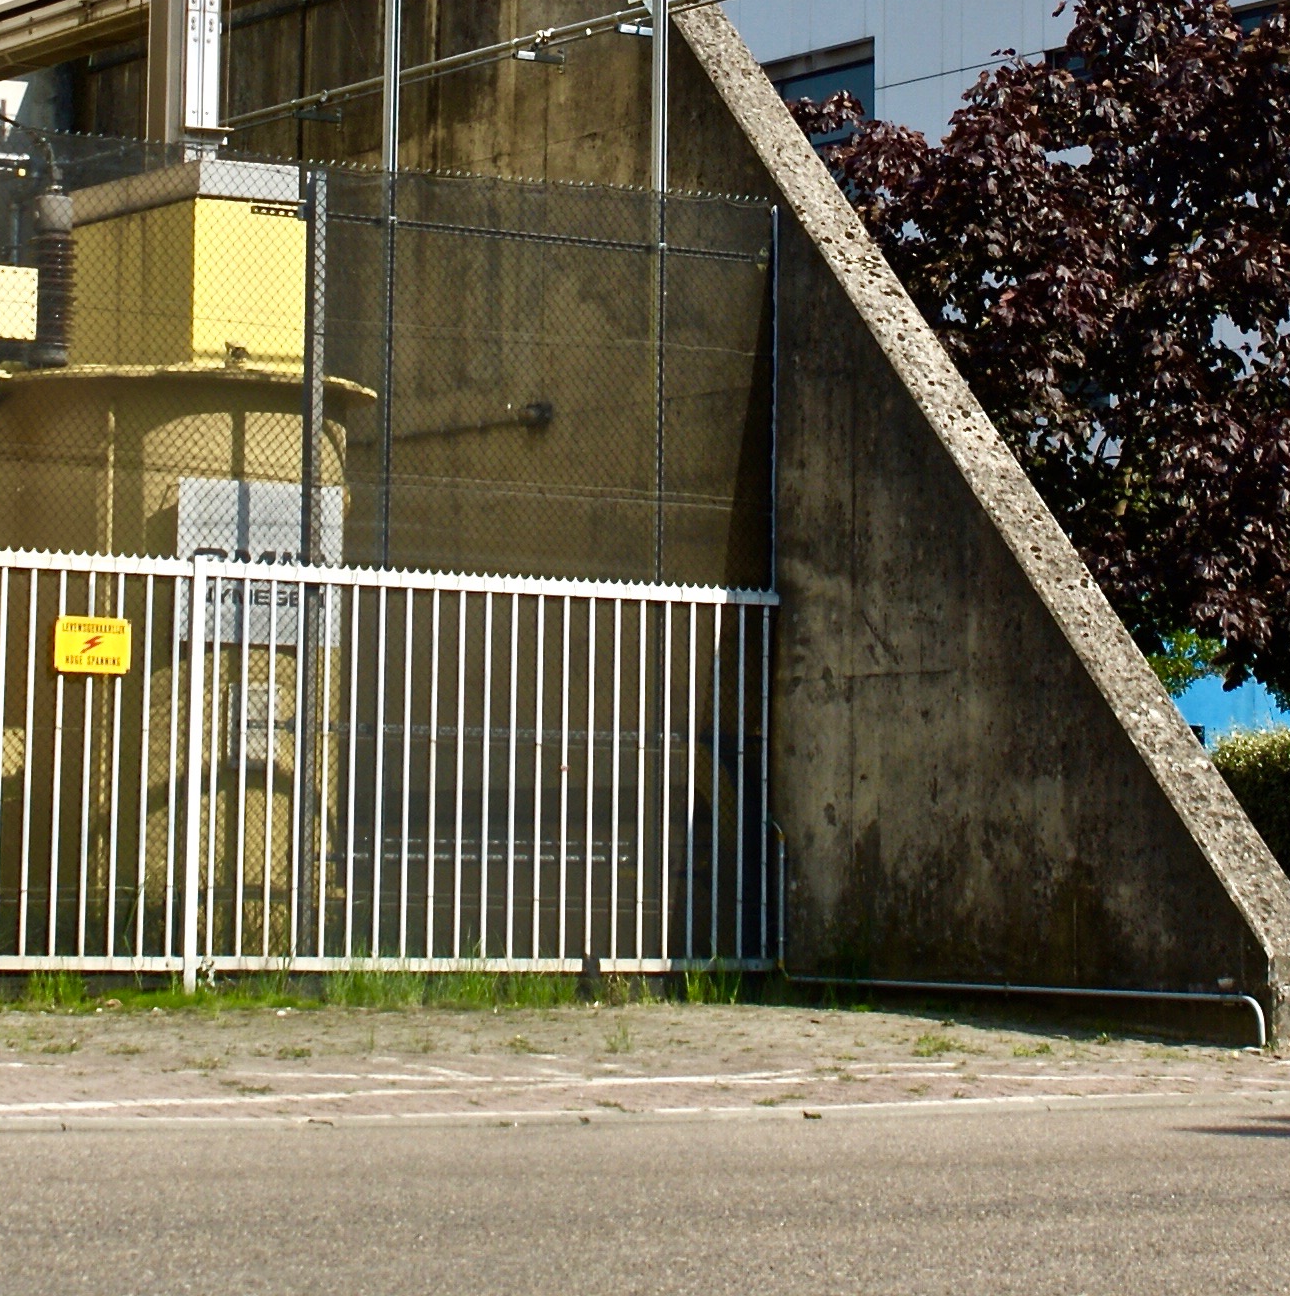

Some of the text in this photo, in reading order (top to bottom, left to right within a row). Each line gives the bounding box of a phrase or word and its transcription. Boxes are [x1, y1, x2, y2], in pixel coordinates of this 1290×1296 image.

[62, 623, 125, 634] LEVENSGEVAARLIJK
[65, 655, 121, 666] HOGE SPANNING
